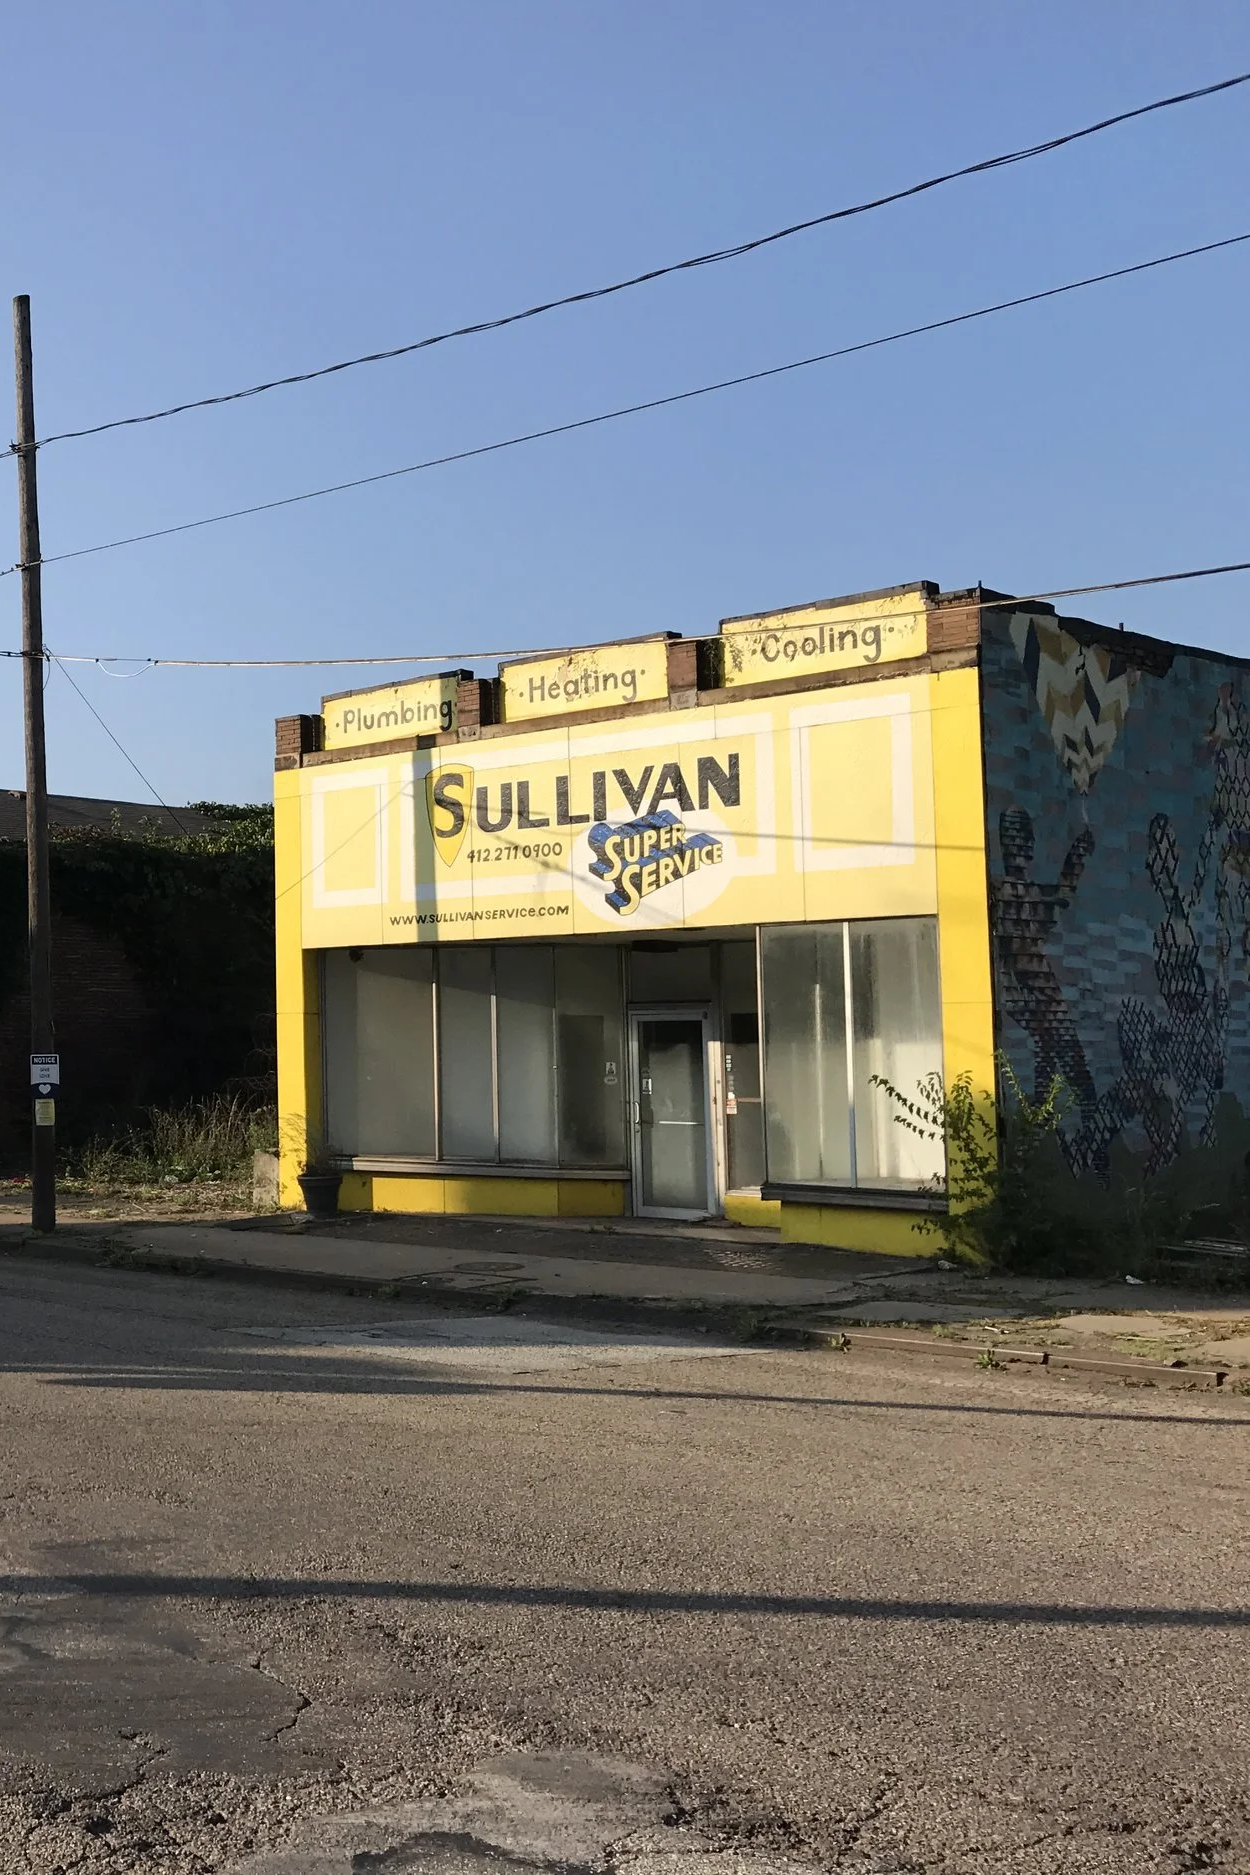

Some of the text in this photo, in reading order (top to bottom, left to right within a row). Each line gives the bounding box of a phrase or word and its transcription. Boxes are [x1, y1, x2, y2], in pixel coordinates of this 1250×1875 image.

[761, 623, 882, 663] Cooling
[528, 668, 638, 703] Heating
[343, 699, 453, 733] Plumbing
[432, 752, 742, 839] SULLIVAN
[466, 842, 563, 864] 412.271.0900
[603, 822, 687, 882] SUPER
[620, 842, 723, 917] SERVICE
